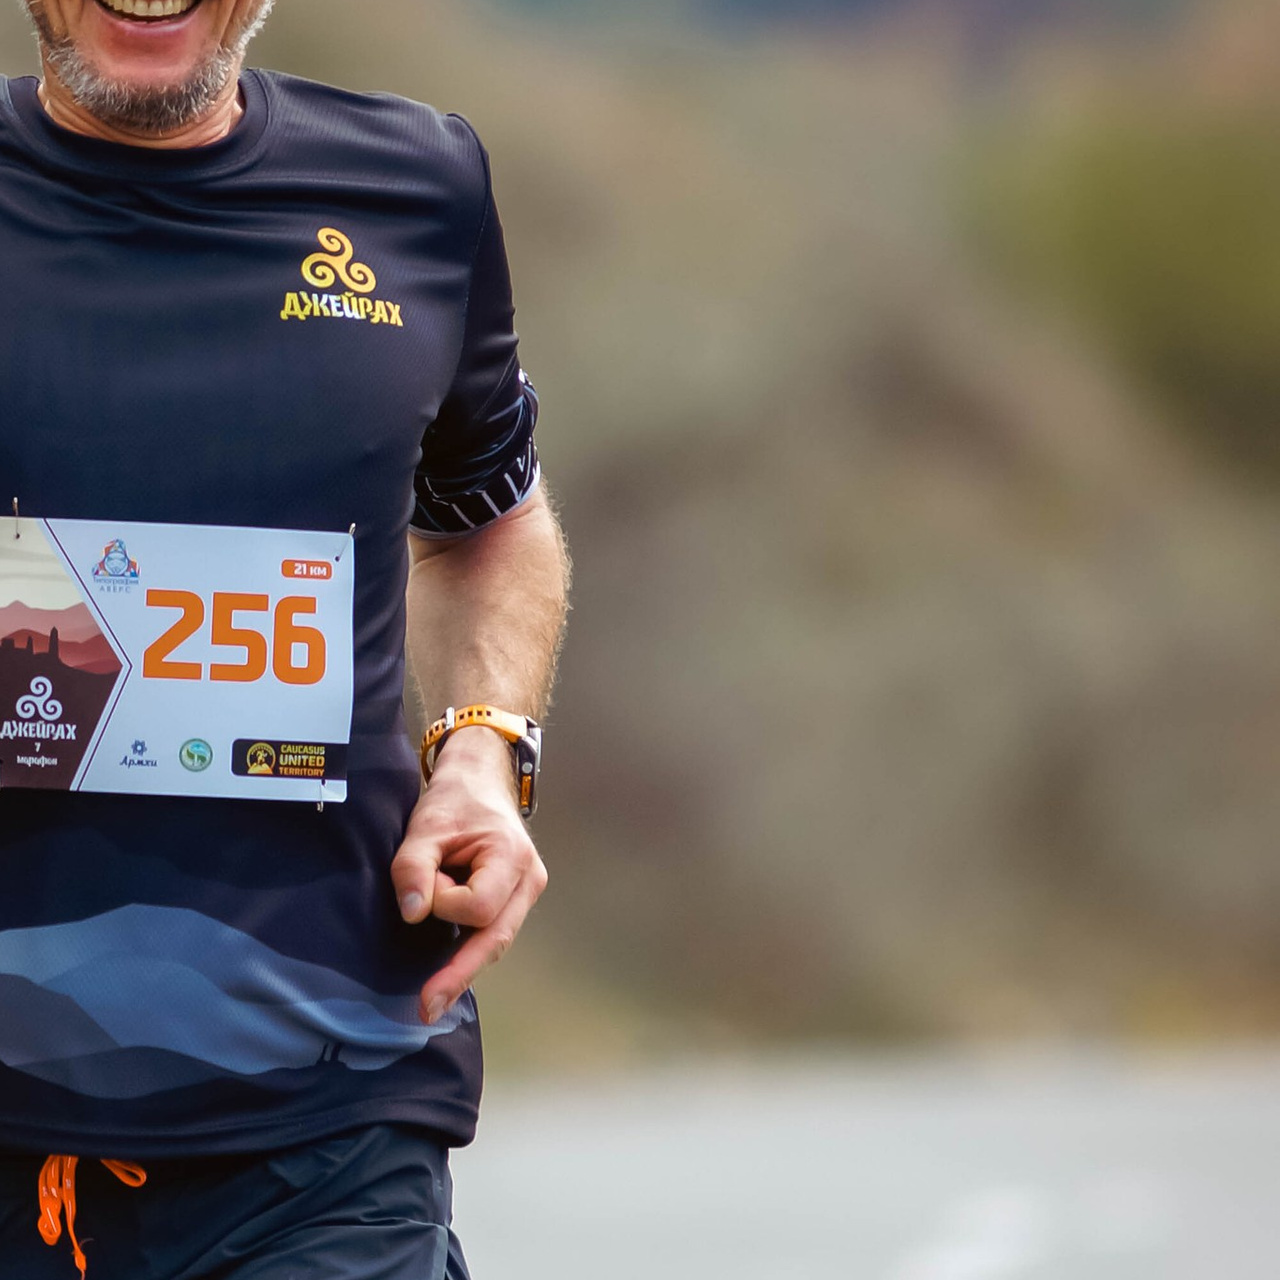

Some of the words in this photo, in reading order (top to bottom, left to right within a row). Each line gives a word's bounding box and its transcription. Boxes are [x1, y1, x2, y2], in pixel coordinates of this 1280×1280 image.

[280, 291, 404, 327] ДЖЕЙРАХ
[294, 562, 307, 575] 21
[141, 588, 327, 685] 256
[0, 720, 78, 740] ДЖЕЙРАХ
[34, 742, 41, 752] 7
[281, 744, 326, 755] CAUCASUS
[120, 755, 158, 769] Армхи
[279, 755, 326, 767] UNITED
[279, 766, 325, 777] TERRITORY
